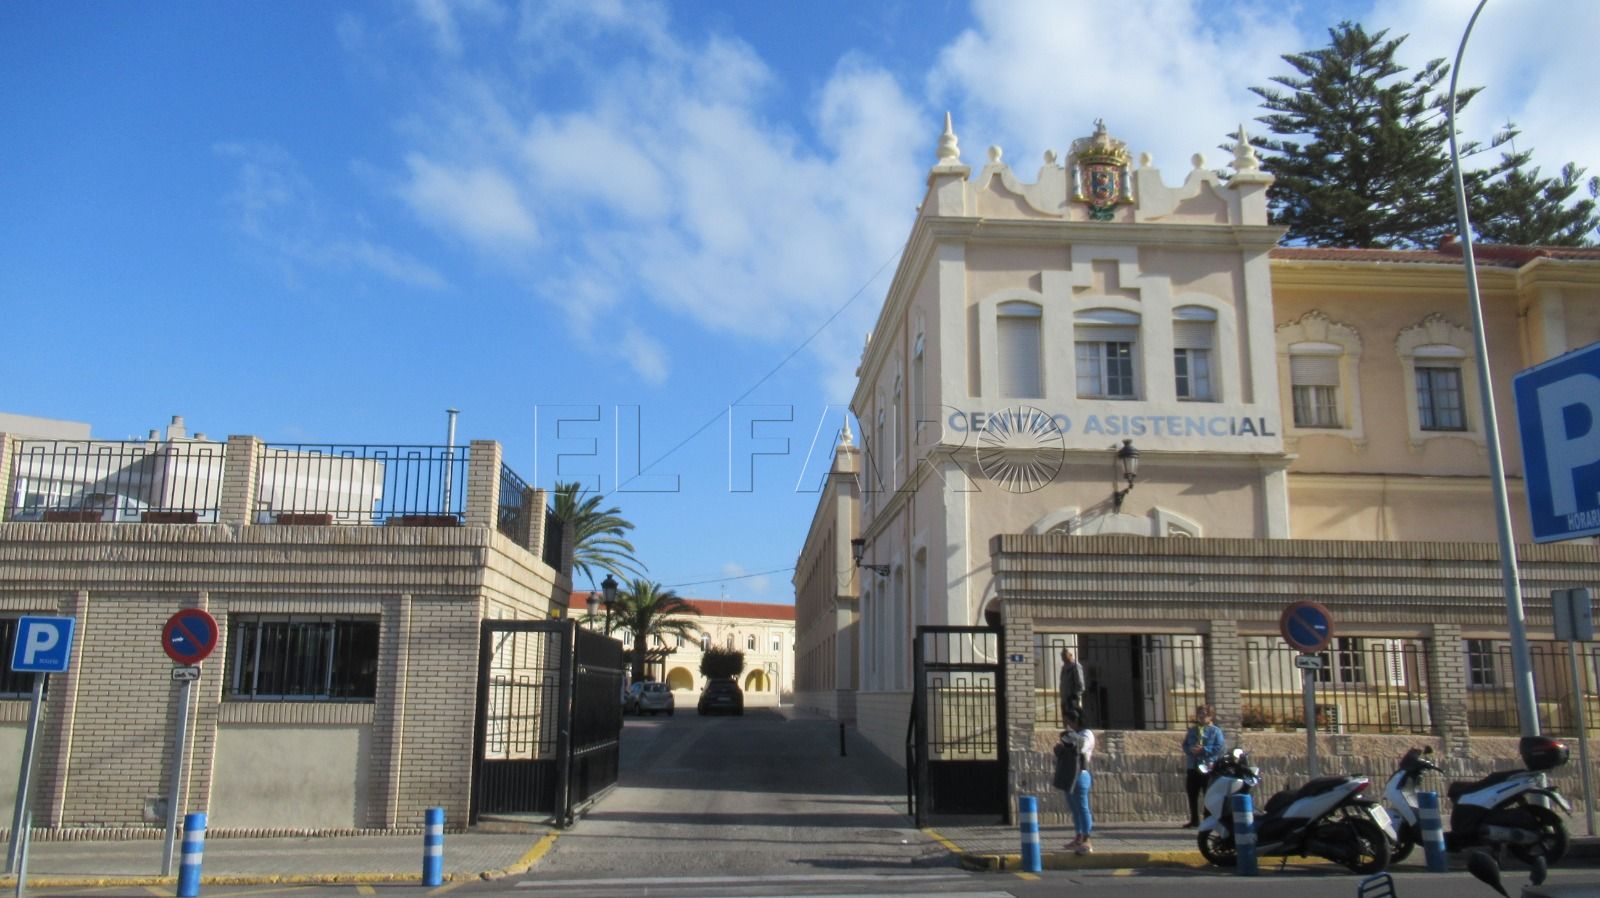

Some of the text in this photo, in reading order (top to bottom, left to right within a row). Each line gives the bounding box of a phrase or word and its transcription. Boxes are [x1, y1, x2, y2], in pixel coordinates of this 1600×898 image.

[948, 411, 1276, 437] CENTRO ASISTENCIAL
[1537, 373, 1600, 516] P
[23, 623, 59, 664] P
